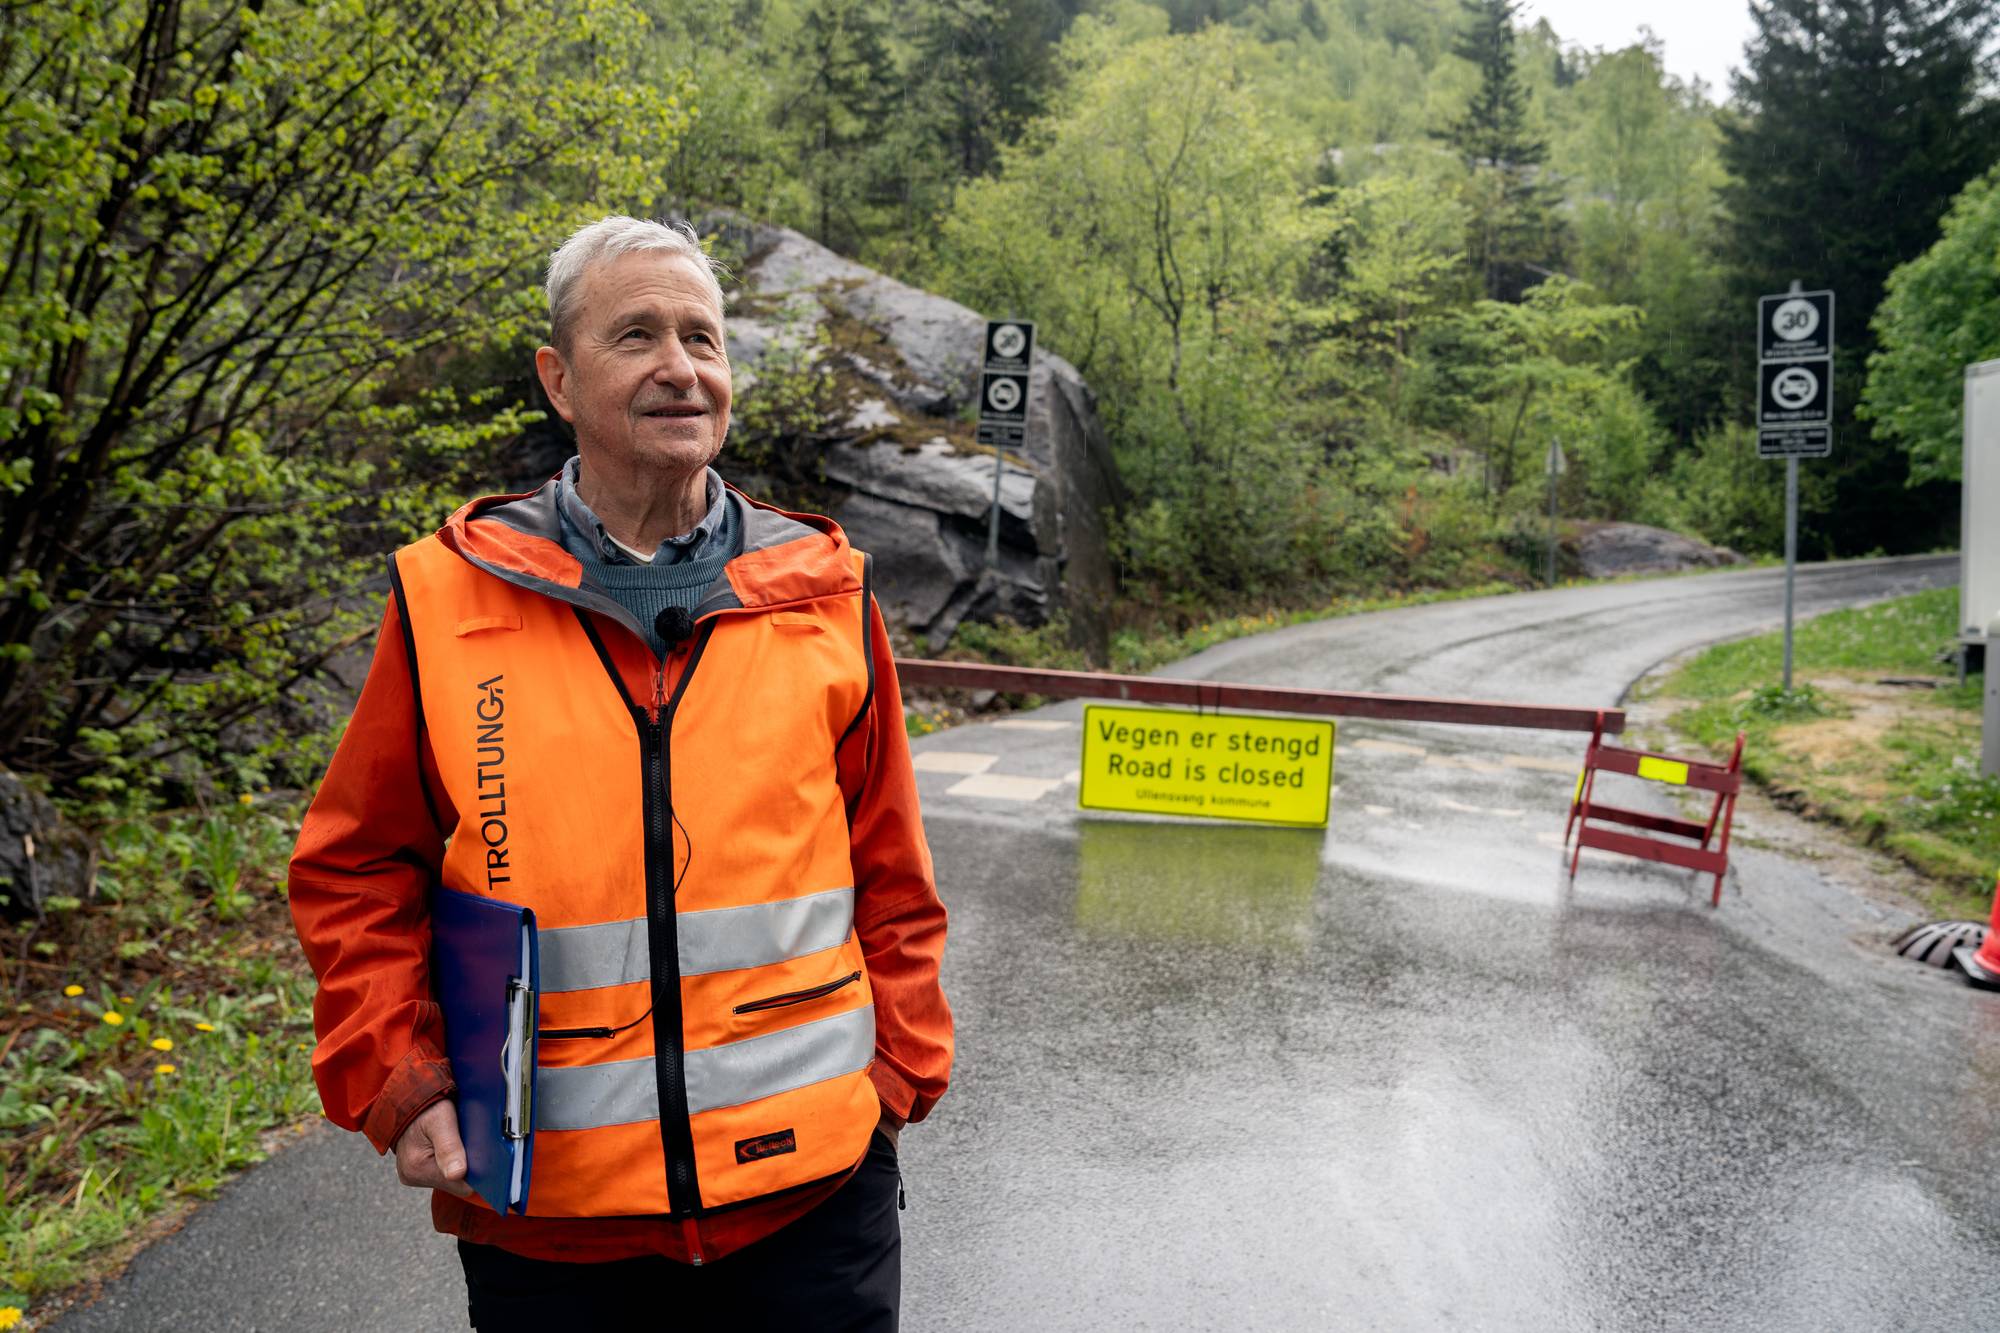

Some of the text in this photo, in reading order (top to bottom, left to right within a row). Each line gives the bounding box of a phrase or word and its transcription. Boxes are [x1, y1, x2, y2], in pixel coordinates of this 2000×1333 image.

[1782, 310, 1809, 330] 30
[1098, 720, 1321, 762] Vegen er stengd
[477, 674, 511, 891] TROLLTUNGA
[1108, 753, 1305, 789] Road is closed
[1210, 794, 1271, 809] kommune
